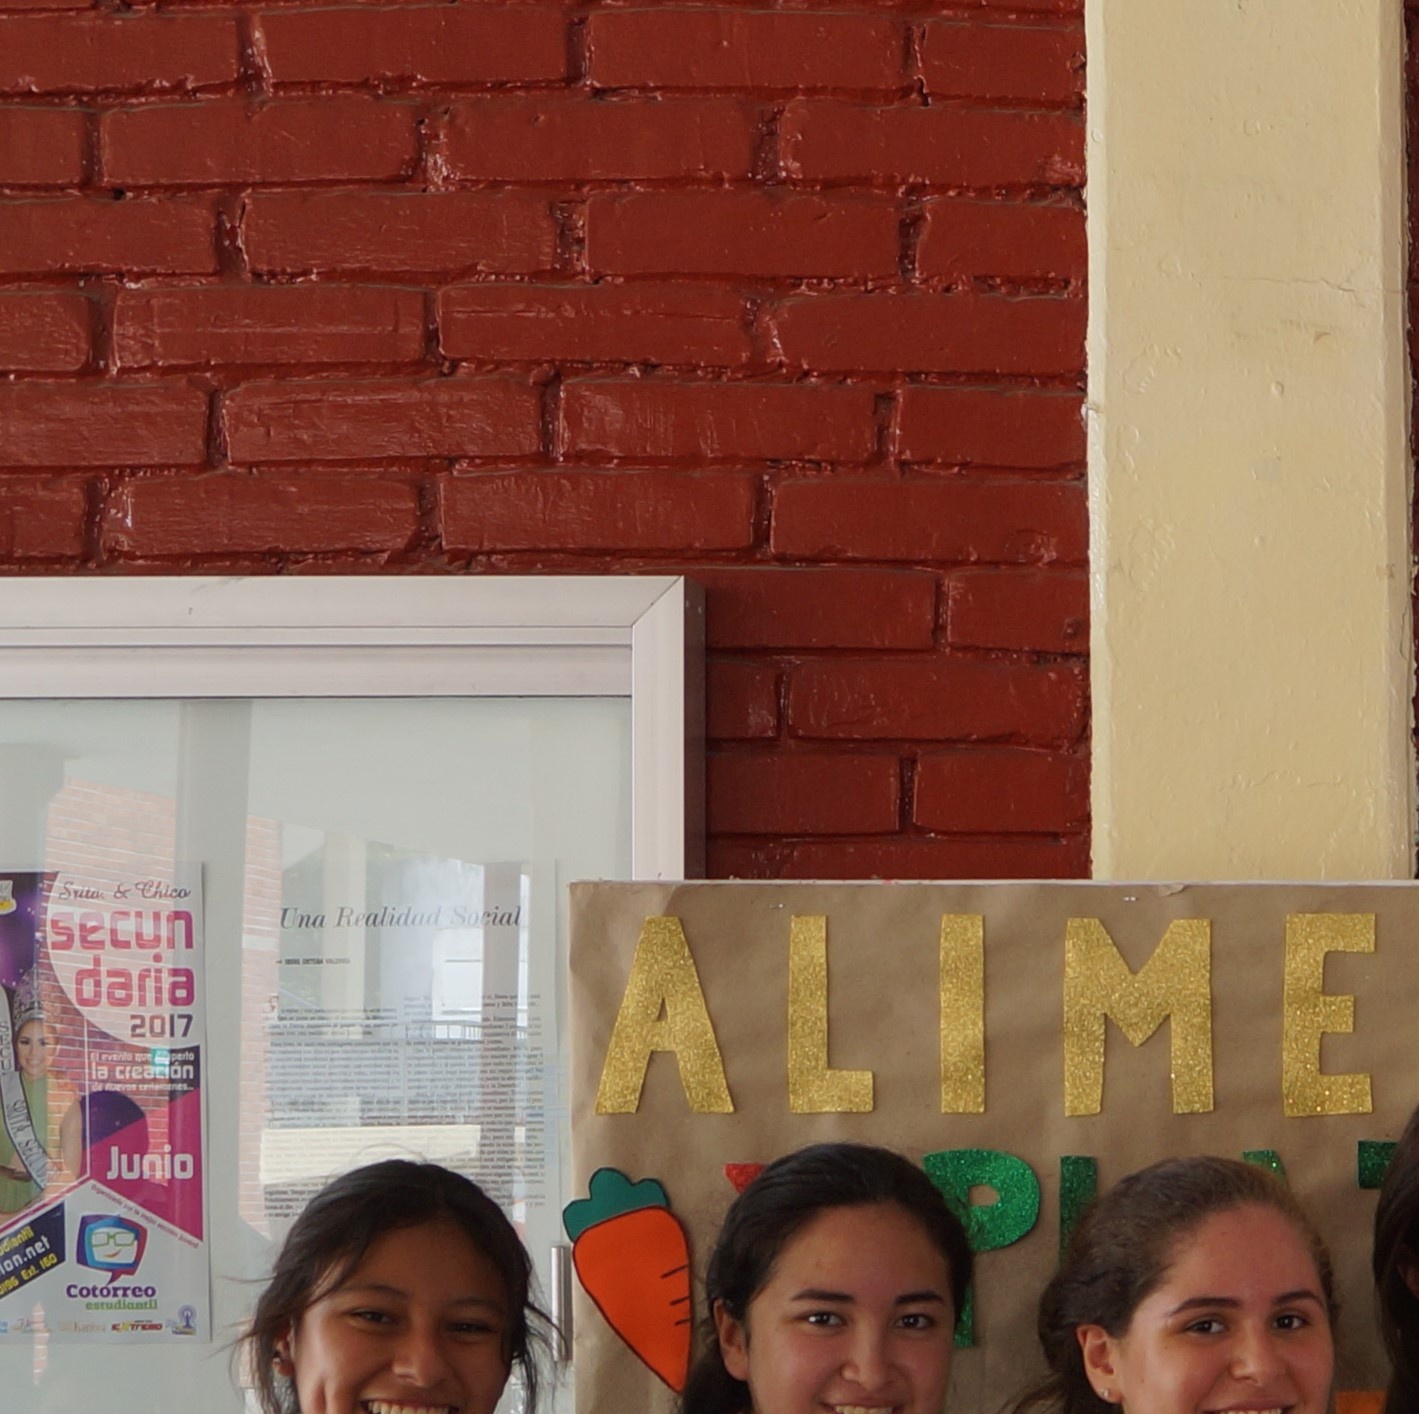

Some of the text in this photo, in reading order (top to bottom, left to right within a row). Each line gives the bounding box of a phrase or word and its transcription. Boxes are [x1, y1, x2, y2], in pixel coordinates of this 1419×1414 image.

[135, 880, 191, 899] Chico
[279, 905, 522, 928] Una Realidad Social
[50, 910, 194, 950] secun
[74, 951, 195, 1007] daria
[130, 1014, 193, 1038] 2017
[91, 1061, 108, 1079] la
[106, 1144, 194, 1180] Junio
[85, 1299, 158, 1310] estudiantil
